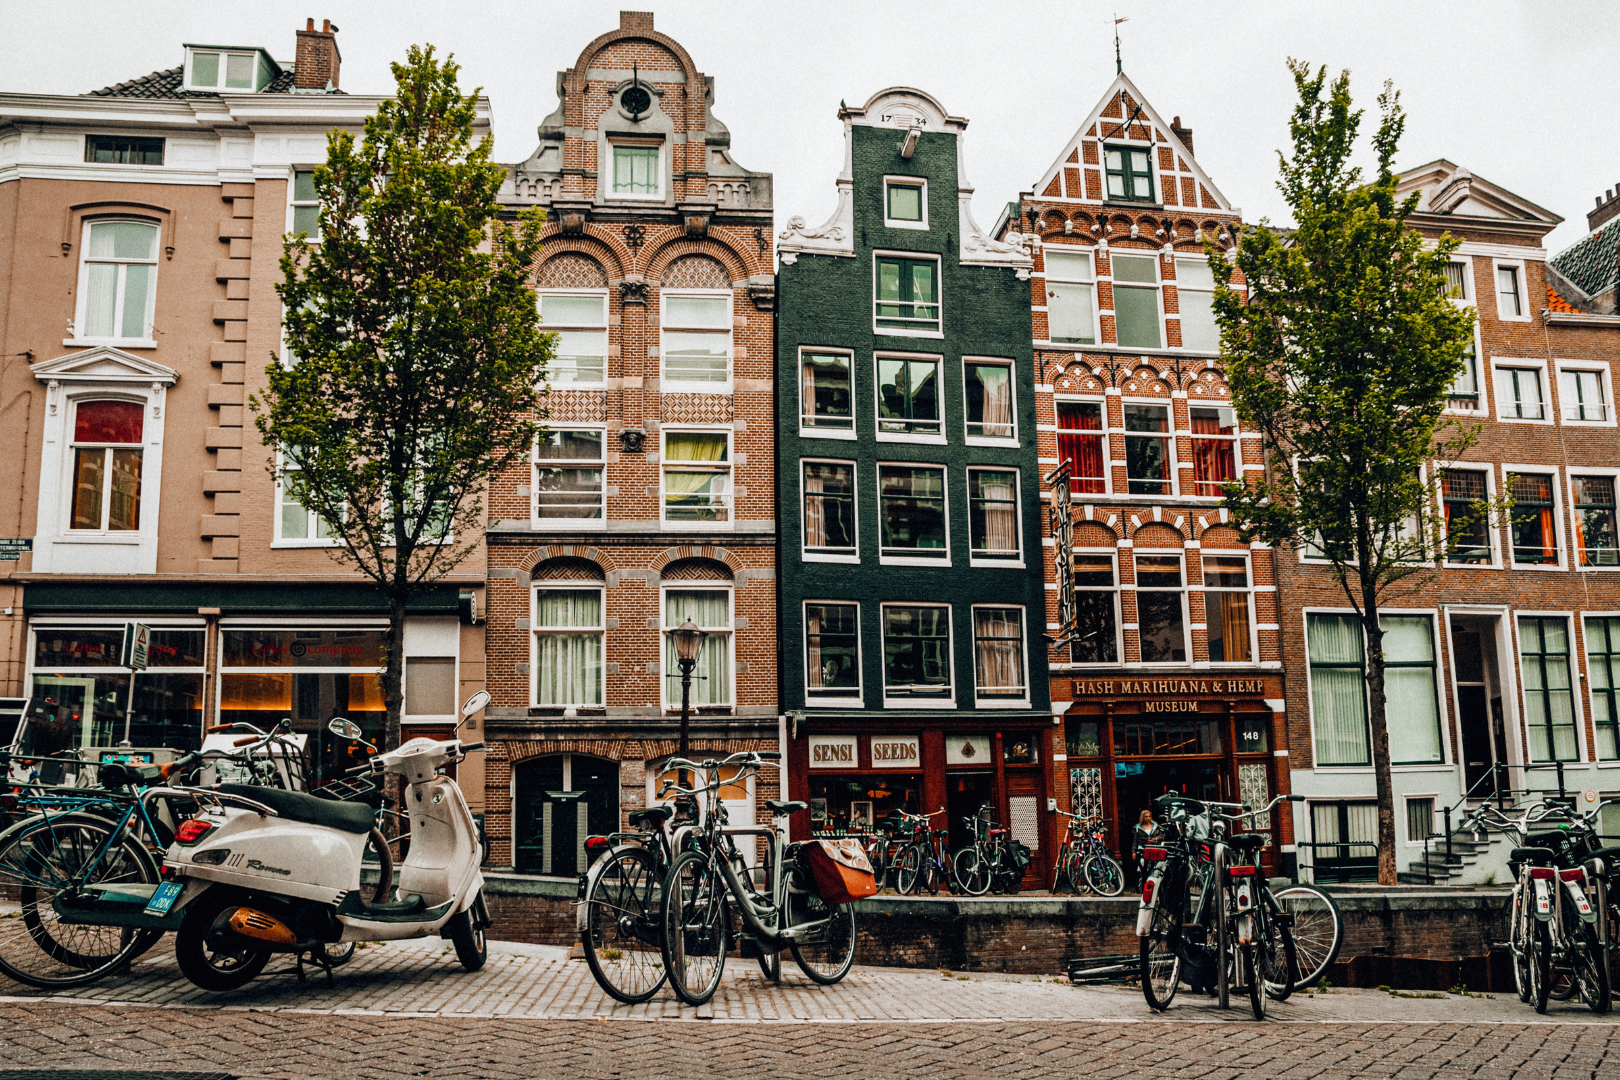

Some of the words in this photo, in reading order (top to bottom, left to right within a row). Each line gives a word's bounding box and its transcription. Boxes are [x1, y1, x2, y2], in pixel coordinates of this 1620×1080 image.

[881, 114, 892, 122] 17
[915, 117, 927, 126] 34
[1058, 504, 1071, 626] MUSEUM
[66, 642, 103, 654] Coffee
[252, 643, 289, 654] Coffee
[306, 643, 362, 658] Company
[1075, 681, 1115, 695] HASH
[1121, 680, 1209, 694] MARIHUANA
[1212, 681, 1223, 693] &
[1227, 680, 1264, 693] HEMP
[1145, 701, 1199, 713] MUSEUM
[1242, 731, 1259, 740] 148
[813, 744, 853, 762] SENSI
[874, 742, 917, 761] SEEDS
